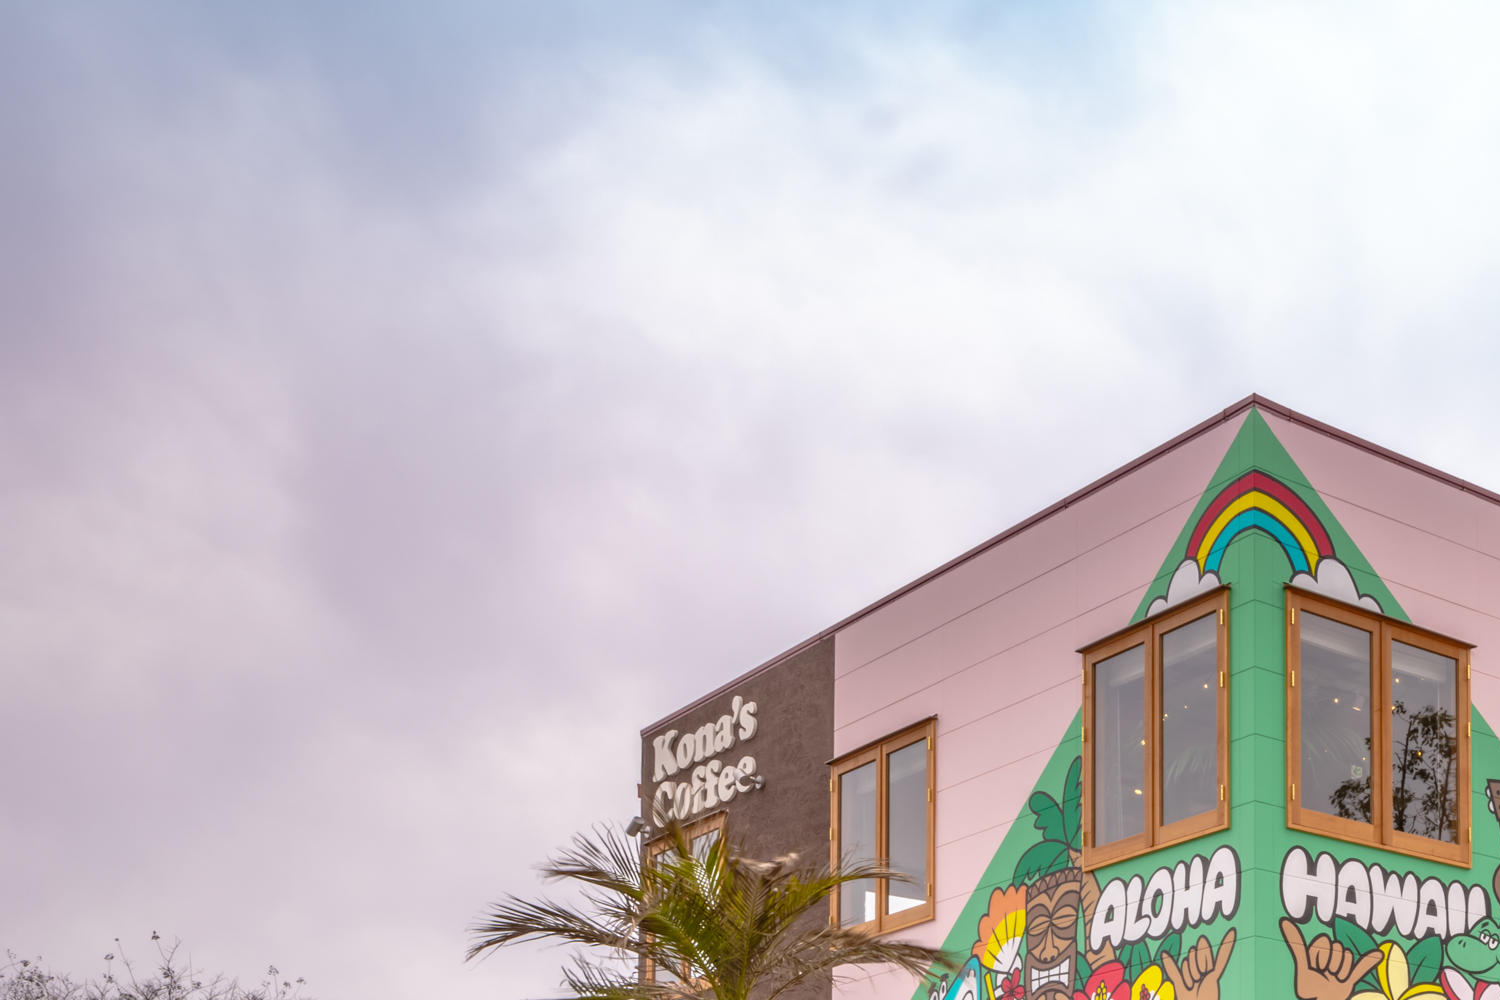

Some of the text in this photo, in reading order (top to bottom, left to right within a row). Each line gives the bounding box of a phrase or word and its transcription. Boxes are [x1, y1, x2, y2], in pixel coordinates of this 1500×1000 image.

[652, 695, 757, 782] Kona's
[1089, 844, 1242, 955] ALOHA
[1280, 845, 1492, 942] HAWAII
